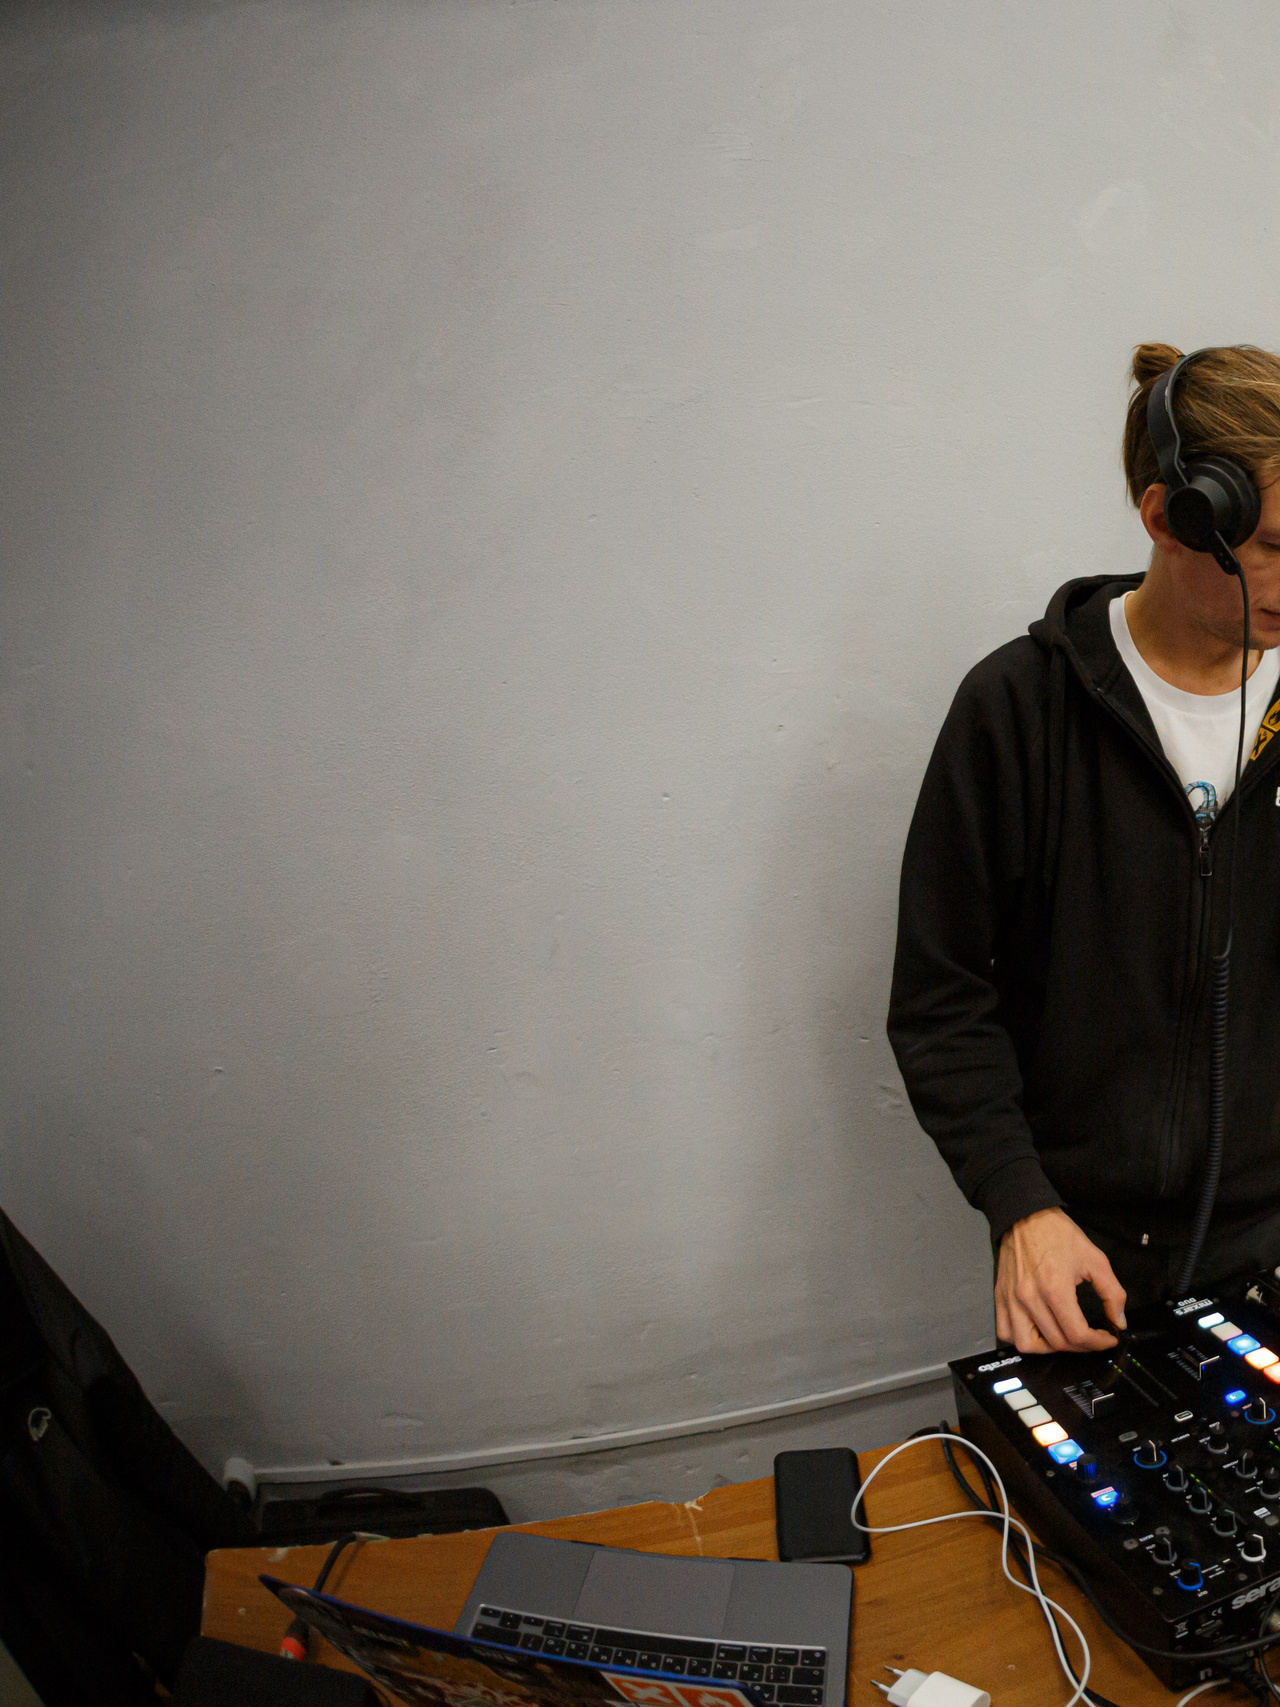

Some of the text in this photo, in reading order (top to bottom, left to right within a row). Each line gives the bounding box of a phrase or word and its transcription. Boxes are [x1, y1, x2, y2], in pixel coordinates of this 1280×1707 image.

[1173, 1299, 1213, 1316] mixars
[1177, 1297, 1197, 1308] DUO
[978, 1355, 1022, 1372] serato
